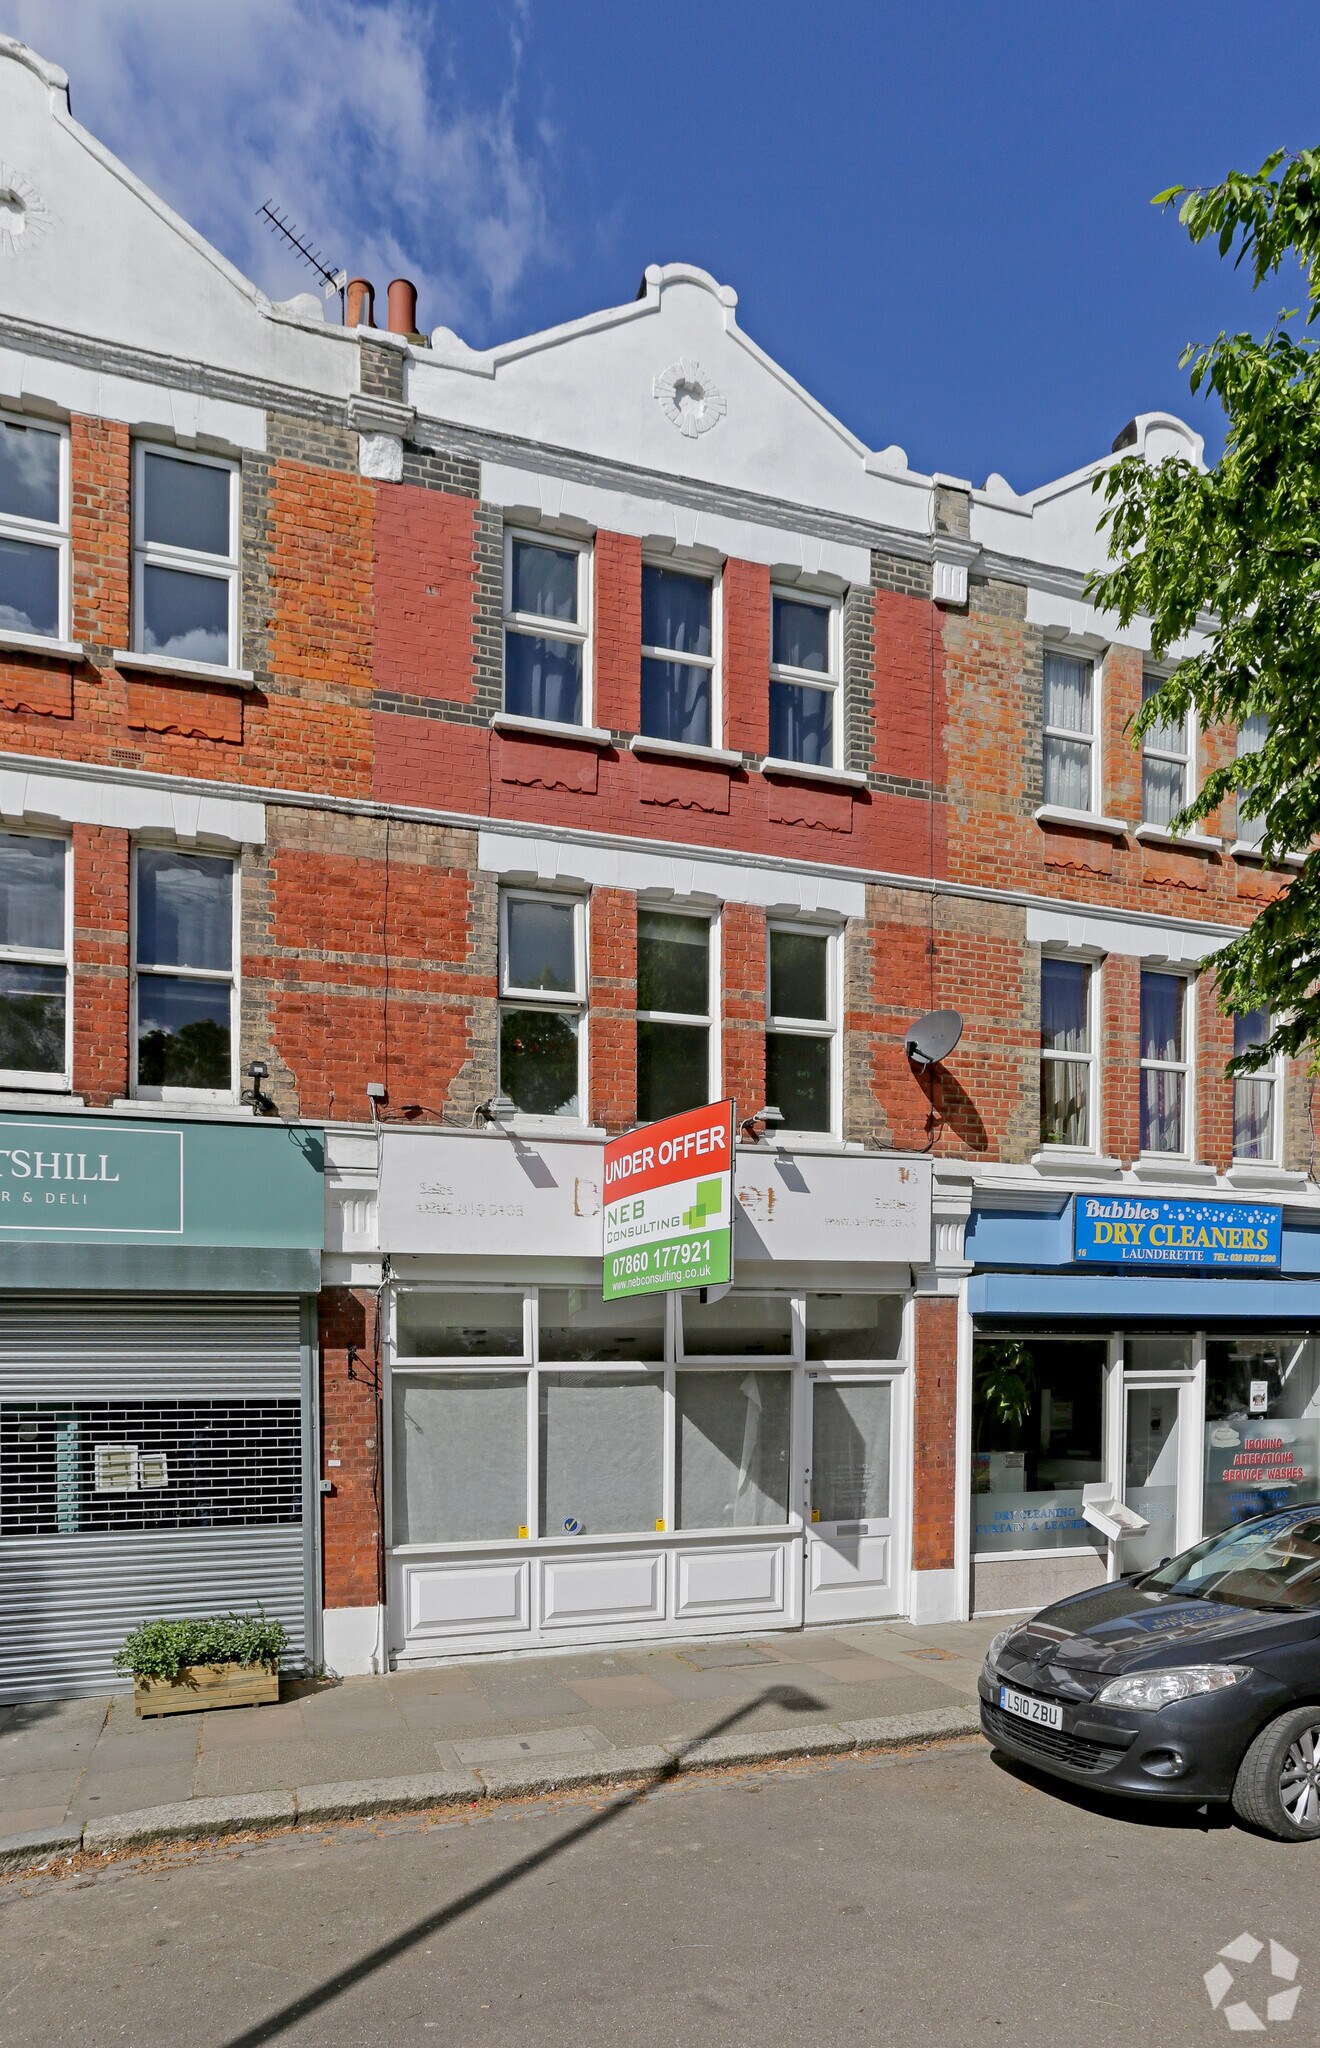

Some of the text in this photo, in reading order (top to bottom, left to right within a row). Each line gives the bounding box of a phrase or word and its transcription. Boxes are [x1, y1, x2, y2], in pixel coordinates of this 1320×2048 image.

[605, 1125, 726, 1185] UNDER OFFER
[22, 1191, 33, 1203] &
[45, 1192, 87, 1205] DELI
[607, 1199, 645, 1228] NEB
[1085, 1199, 1160, 1220] Bubbles
[607, 1216, 680, 1244] CONSULTING
[1093, 1221, 1269, 1250] DRY CLEANERS
[612, 1239, 711, 1278] 07860 177921
[1077, 1248, 1087, 1257] 16
[1121, 1248, 1204, 1261] LAUNDERETTE
[1213, 1252, 1229, 1262] TEL:
[1230, 1253, 1242, 1262] 020
[611, 1264, 712, 1291] www.nebconsulting.co.uk
[1244, 1438, 1283, 1450] IRONING
[1233, 1451, 1294, 1466] ALTERATIONS
[1222, 1466, 1305, 1482] SERVICE WASHES
[994, 1508, 1076, 1521] DRY CLEANING
[1008, 1693, 1057, 1725] LS10 ZBU
